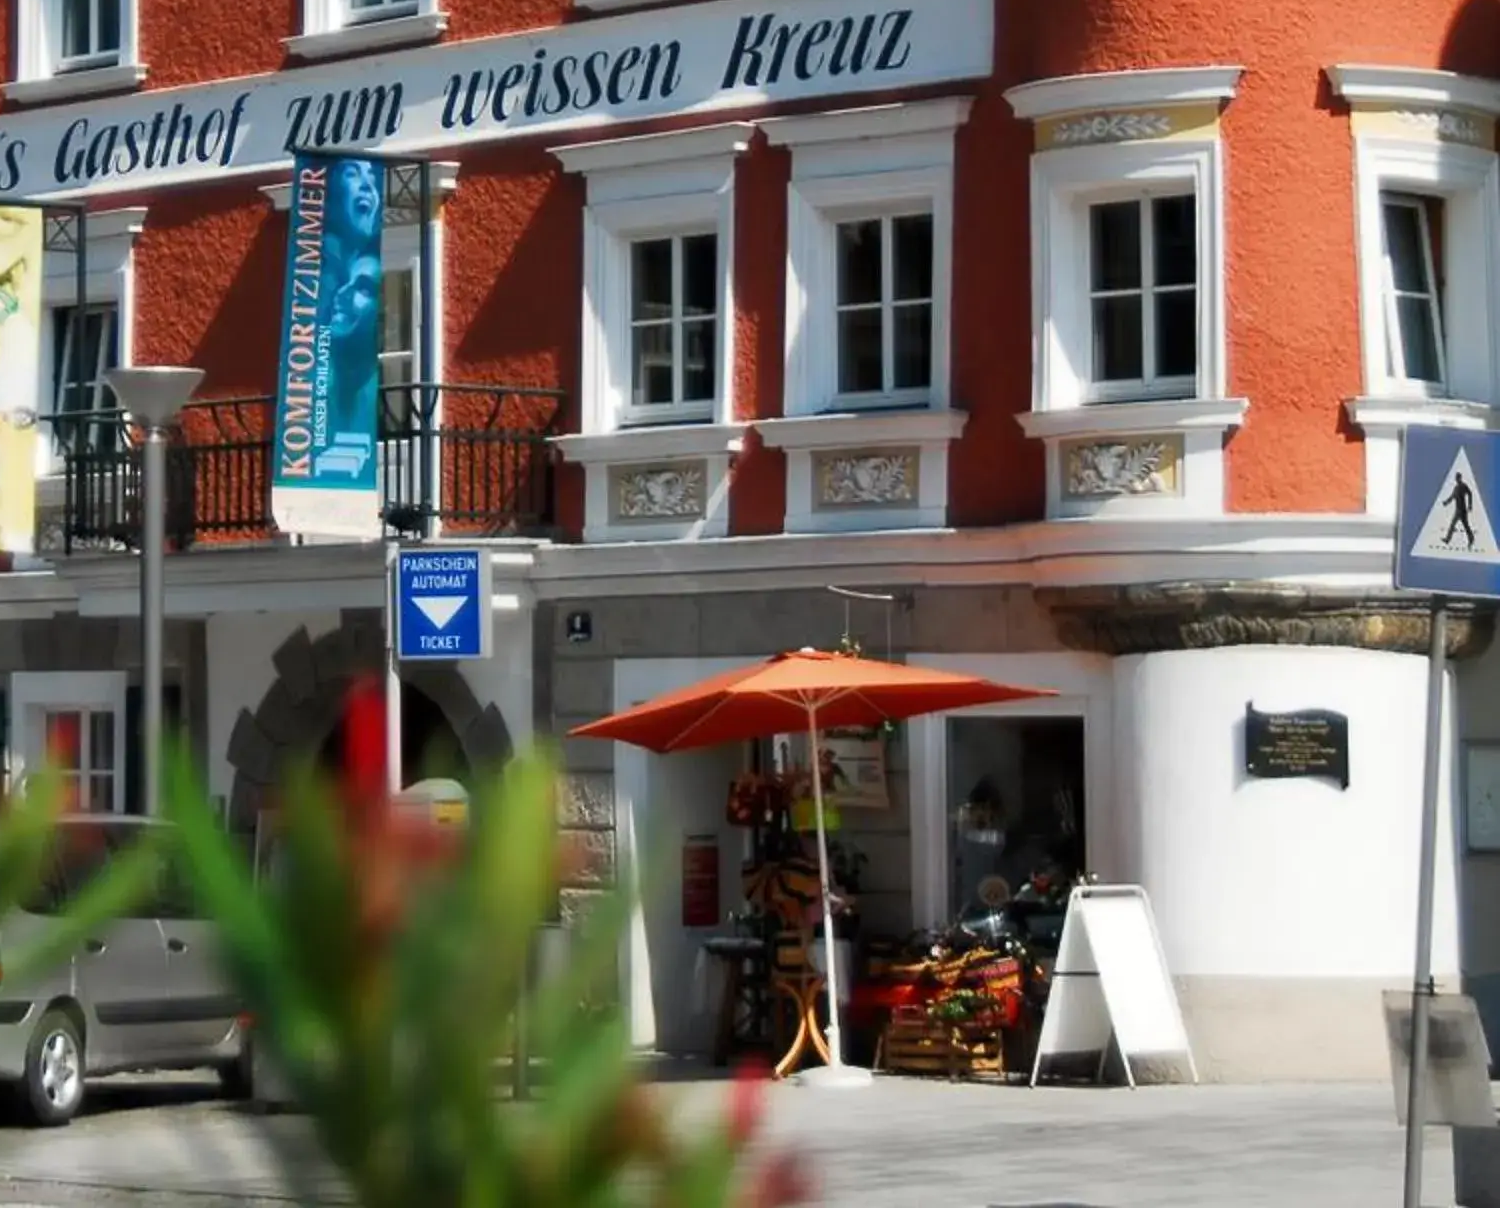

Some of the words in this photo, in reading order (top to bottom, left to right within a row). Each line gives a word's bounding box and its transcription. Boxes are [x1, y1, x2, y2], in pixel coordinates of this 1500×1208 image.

[53, 92, 250, 184] Gasthof
[285, 81, 404, 152] zum
[440, 38, 681, 129] weissen
[720, 9, 913, 90] Kreuz
[280, 165, 327, 478] KOMFORTZIMMER
[403, 557, 477, 571] PARKSCHEIN
[411, 574, 468, 589] AUTOMAT
[420, 635, 461, 649] TICKET
